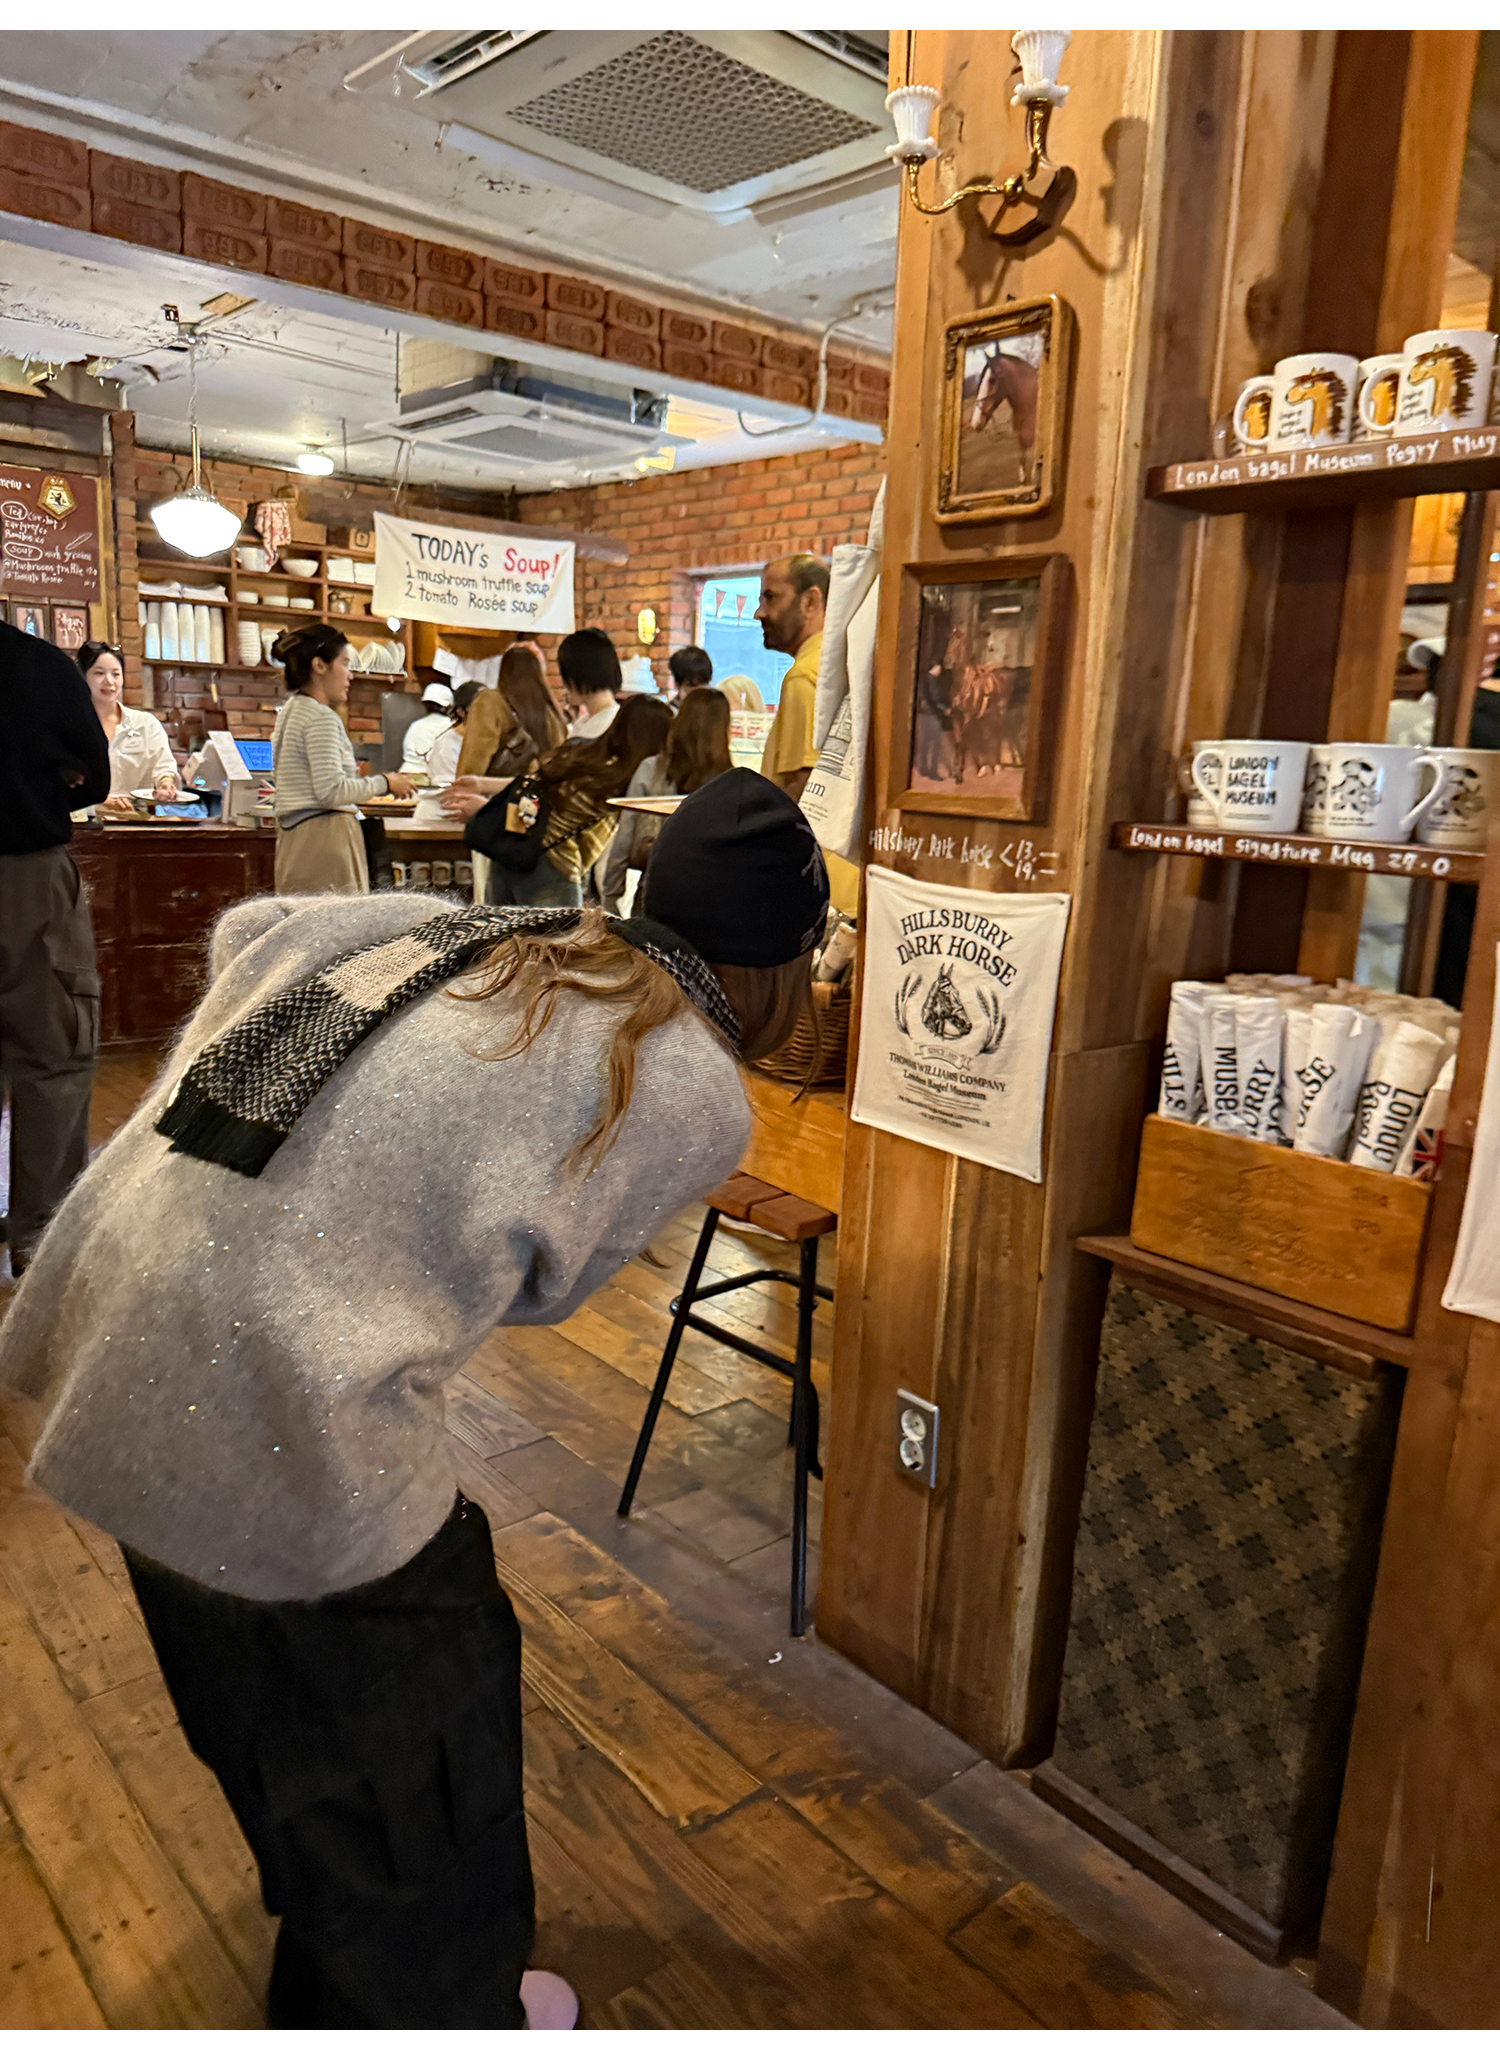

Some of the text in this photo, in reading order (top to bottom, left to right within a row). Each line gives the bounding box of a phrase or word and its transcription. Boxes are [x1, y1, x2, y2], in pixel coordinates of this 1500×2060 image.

[1174, 464, 1240, 490] London
[1247, 453, 1297, 481] bagel
[1304, 453, 1374, 473] Museum
[1451, 434, 1498, 456] Mug
[411, 532, 560, 580] TODAY's Soup!
[416, 569, 478, 589] mushroom
[482, 576, 521, 593] truffle
[524, 582, 550, 599] soup
[418, 583, 459, 607] tomato
[511, 599, 539, 617] soup
[1130, 827, 1181, 849] London
[1329, 844, 1376, 871] Mug
[900, 908, 1014, 951] HILLSBURRY
[896, 934, 1018, 987] DARK HORSE
[959, 1073, 1007, 1092] COMPANY
